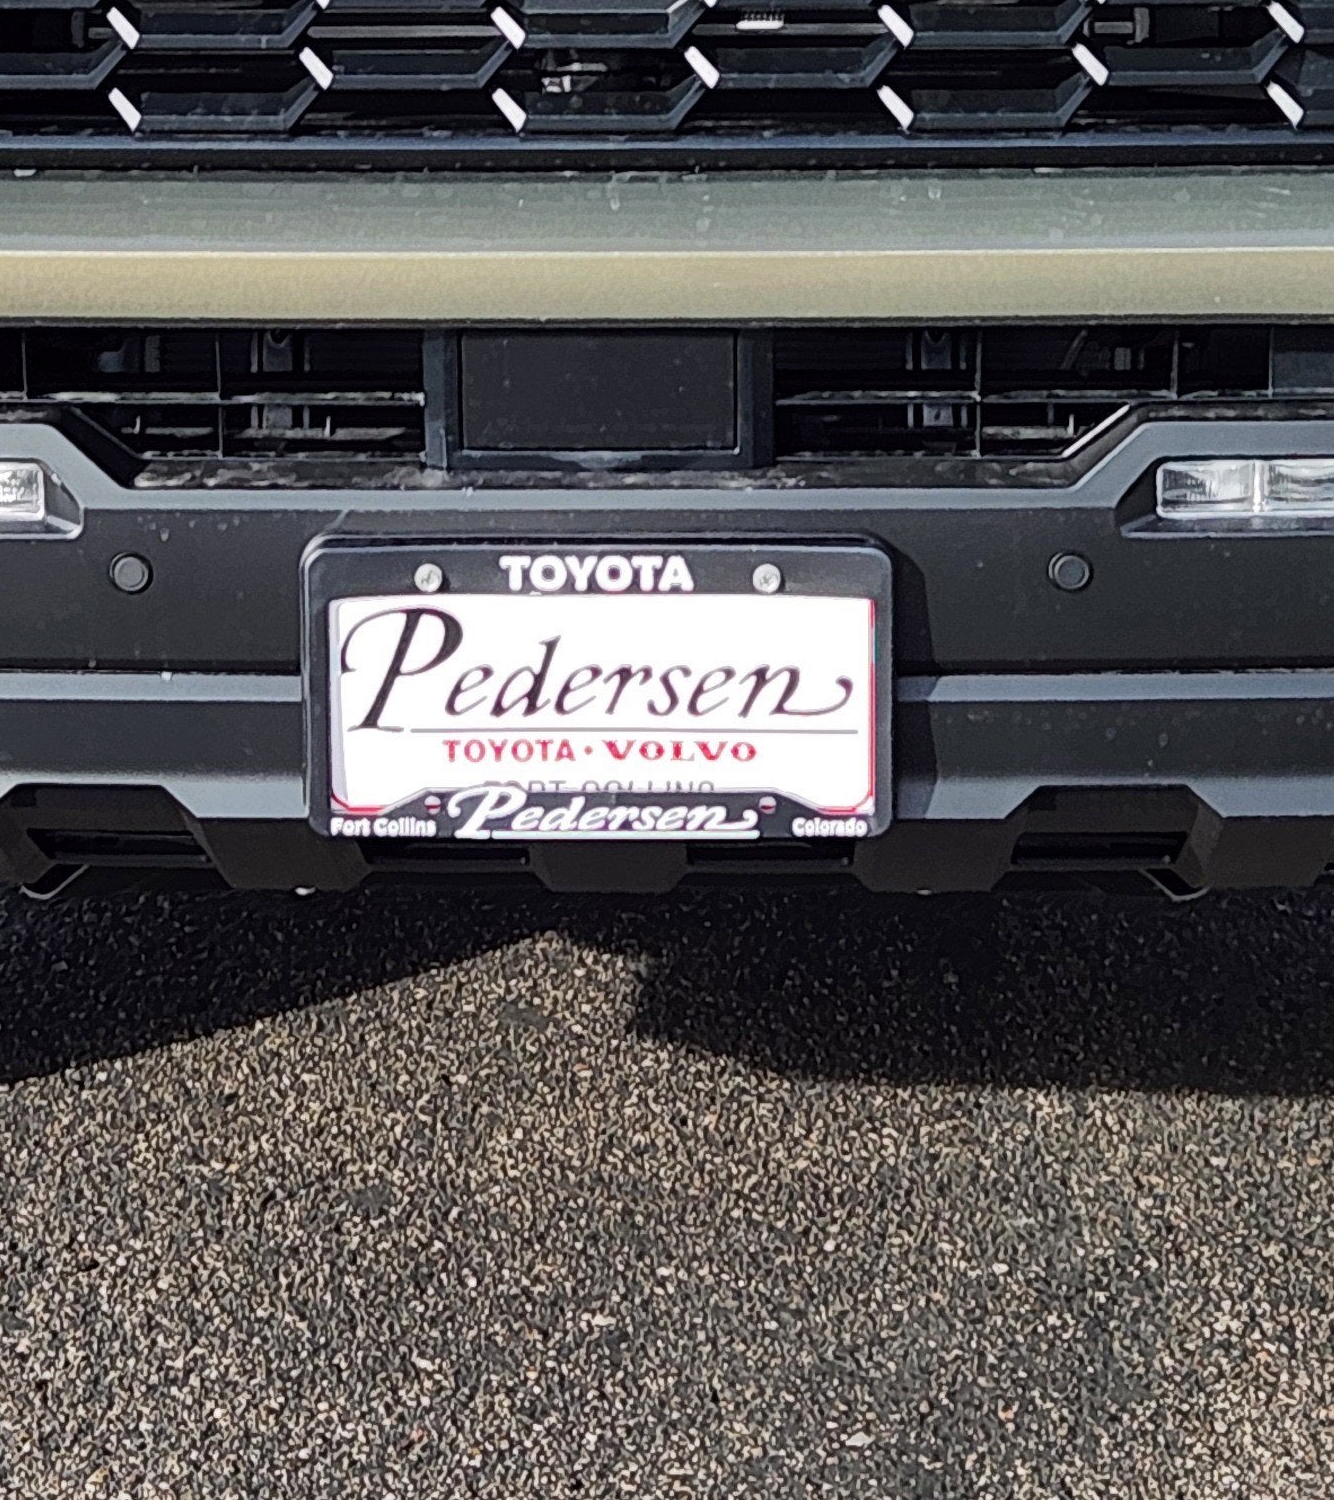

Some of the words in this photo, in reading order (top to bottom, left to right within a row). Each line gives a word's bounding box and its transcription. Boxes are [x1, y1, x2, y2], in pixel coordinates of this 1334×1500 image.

[499, 555, 695, 592] TOYOTA
[340, 606, 854, 733] Pedersen
[442, 738, 576, 763] TOYOTA
[602, 738, 757, 763] VOLVO
[330, 816, 371, 837] Fort
[373, 816, 437, 838] Collins
[446, 784, 759, 839] Pedersen
[791, 816, 868, 838] Colorado
